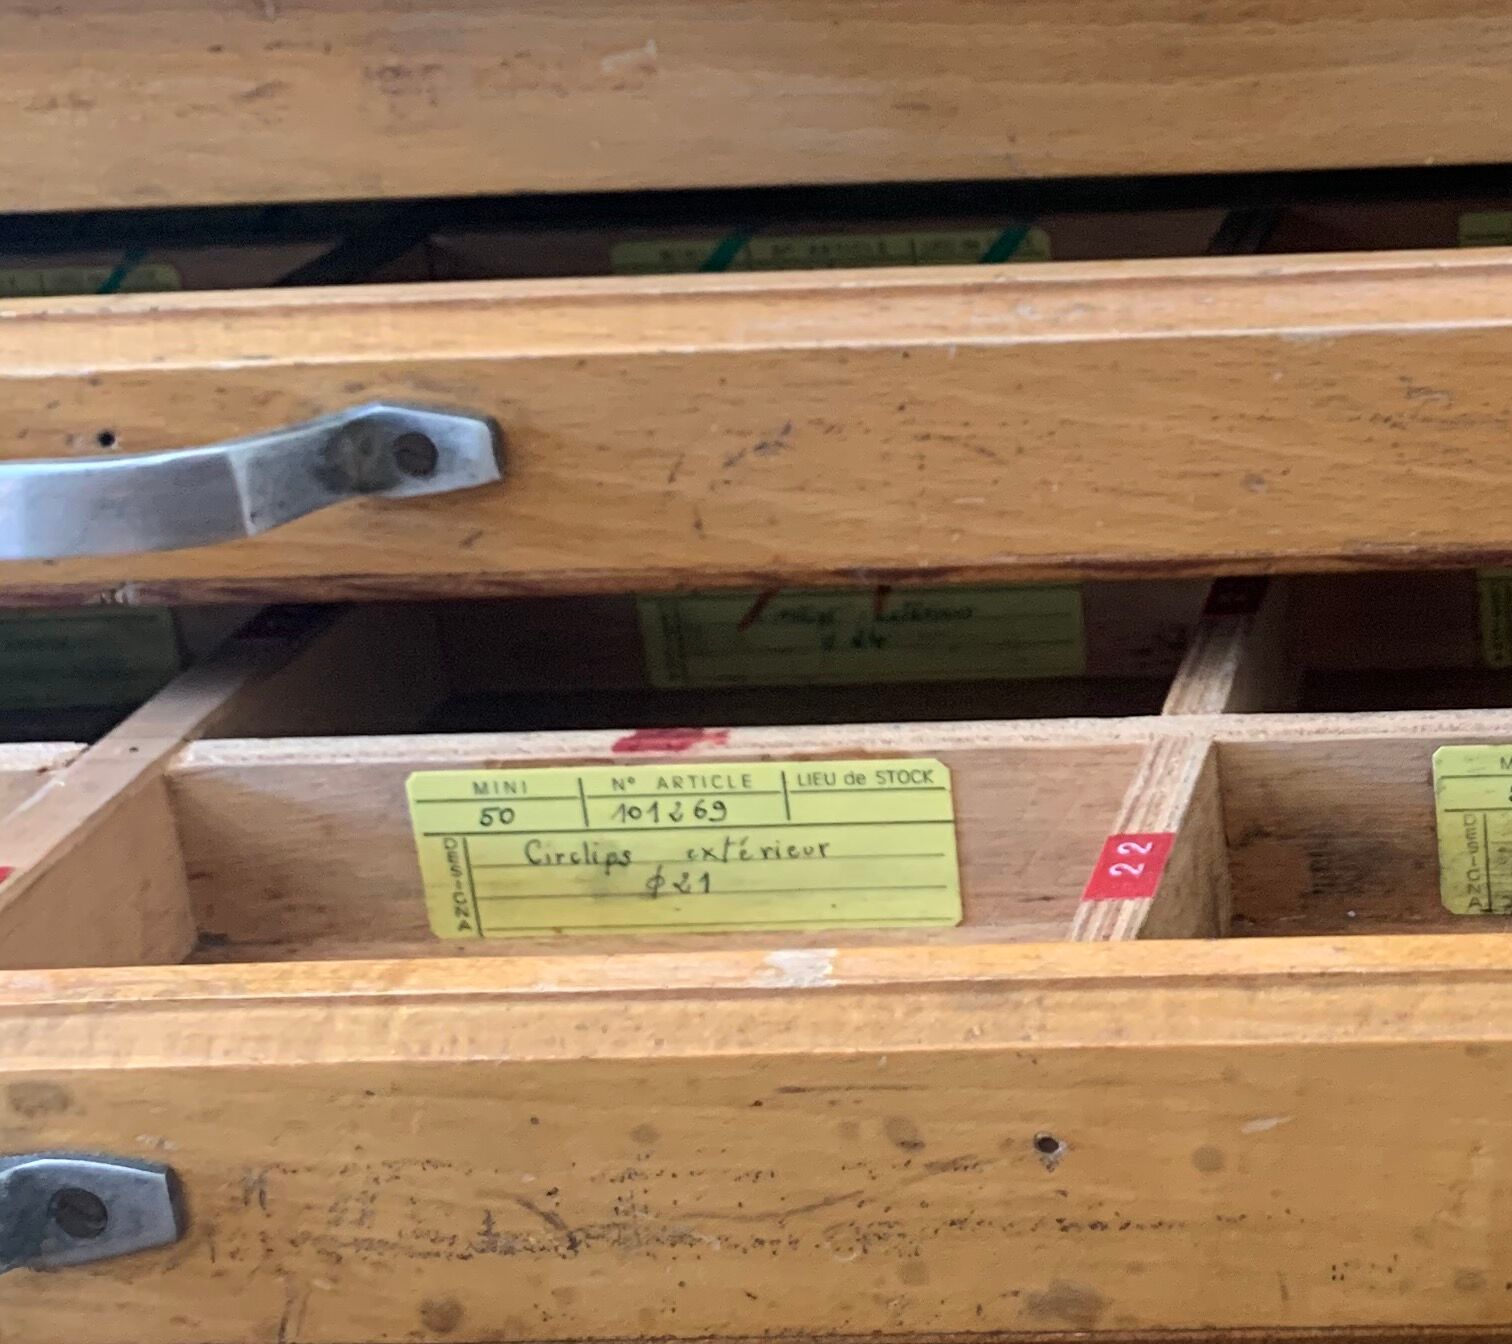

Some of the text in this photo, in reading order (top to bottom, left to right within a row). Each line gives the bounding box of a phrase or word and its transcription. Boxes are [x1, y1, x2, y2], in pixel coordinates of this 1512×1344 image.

[473, 780, 528, 796] MINI
[656, 773, 753, 791] ARTICLE
[796, 772, 836, 787] LIEU
[844, 771, 867, 786] de
[875, 768, 935, 786] STOCK
[479, 799, 728, 827] 50 101269
[523, 838, 633, 876] Circlips
[1109, 841, 1153, 877] 22
